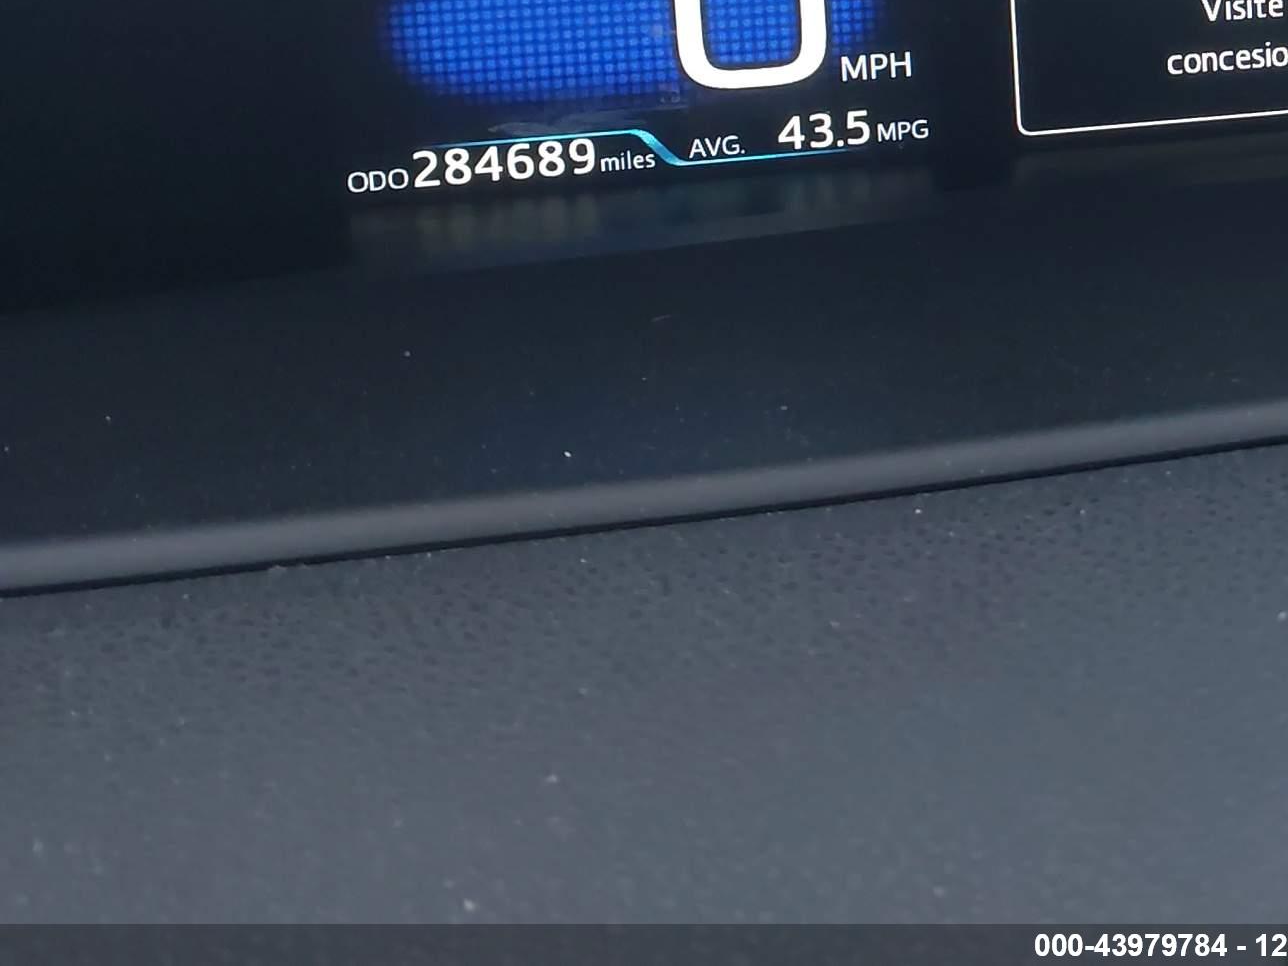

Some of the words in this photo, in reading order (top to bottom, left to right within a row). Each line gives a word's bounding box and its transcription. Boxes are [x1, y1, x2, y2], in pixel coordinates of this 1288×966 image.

[840, 52, 913, 82] MPH
[688, 137, 746, 161] AVG.
[777, 109, 872, 152] 43.5
[876, 120, 930, 143] MPG
[347, 170, 409, 194] ODO
[411, 137, 597, 188] 284689
[600, 149, 656, 174] miles
